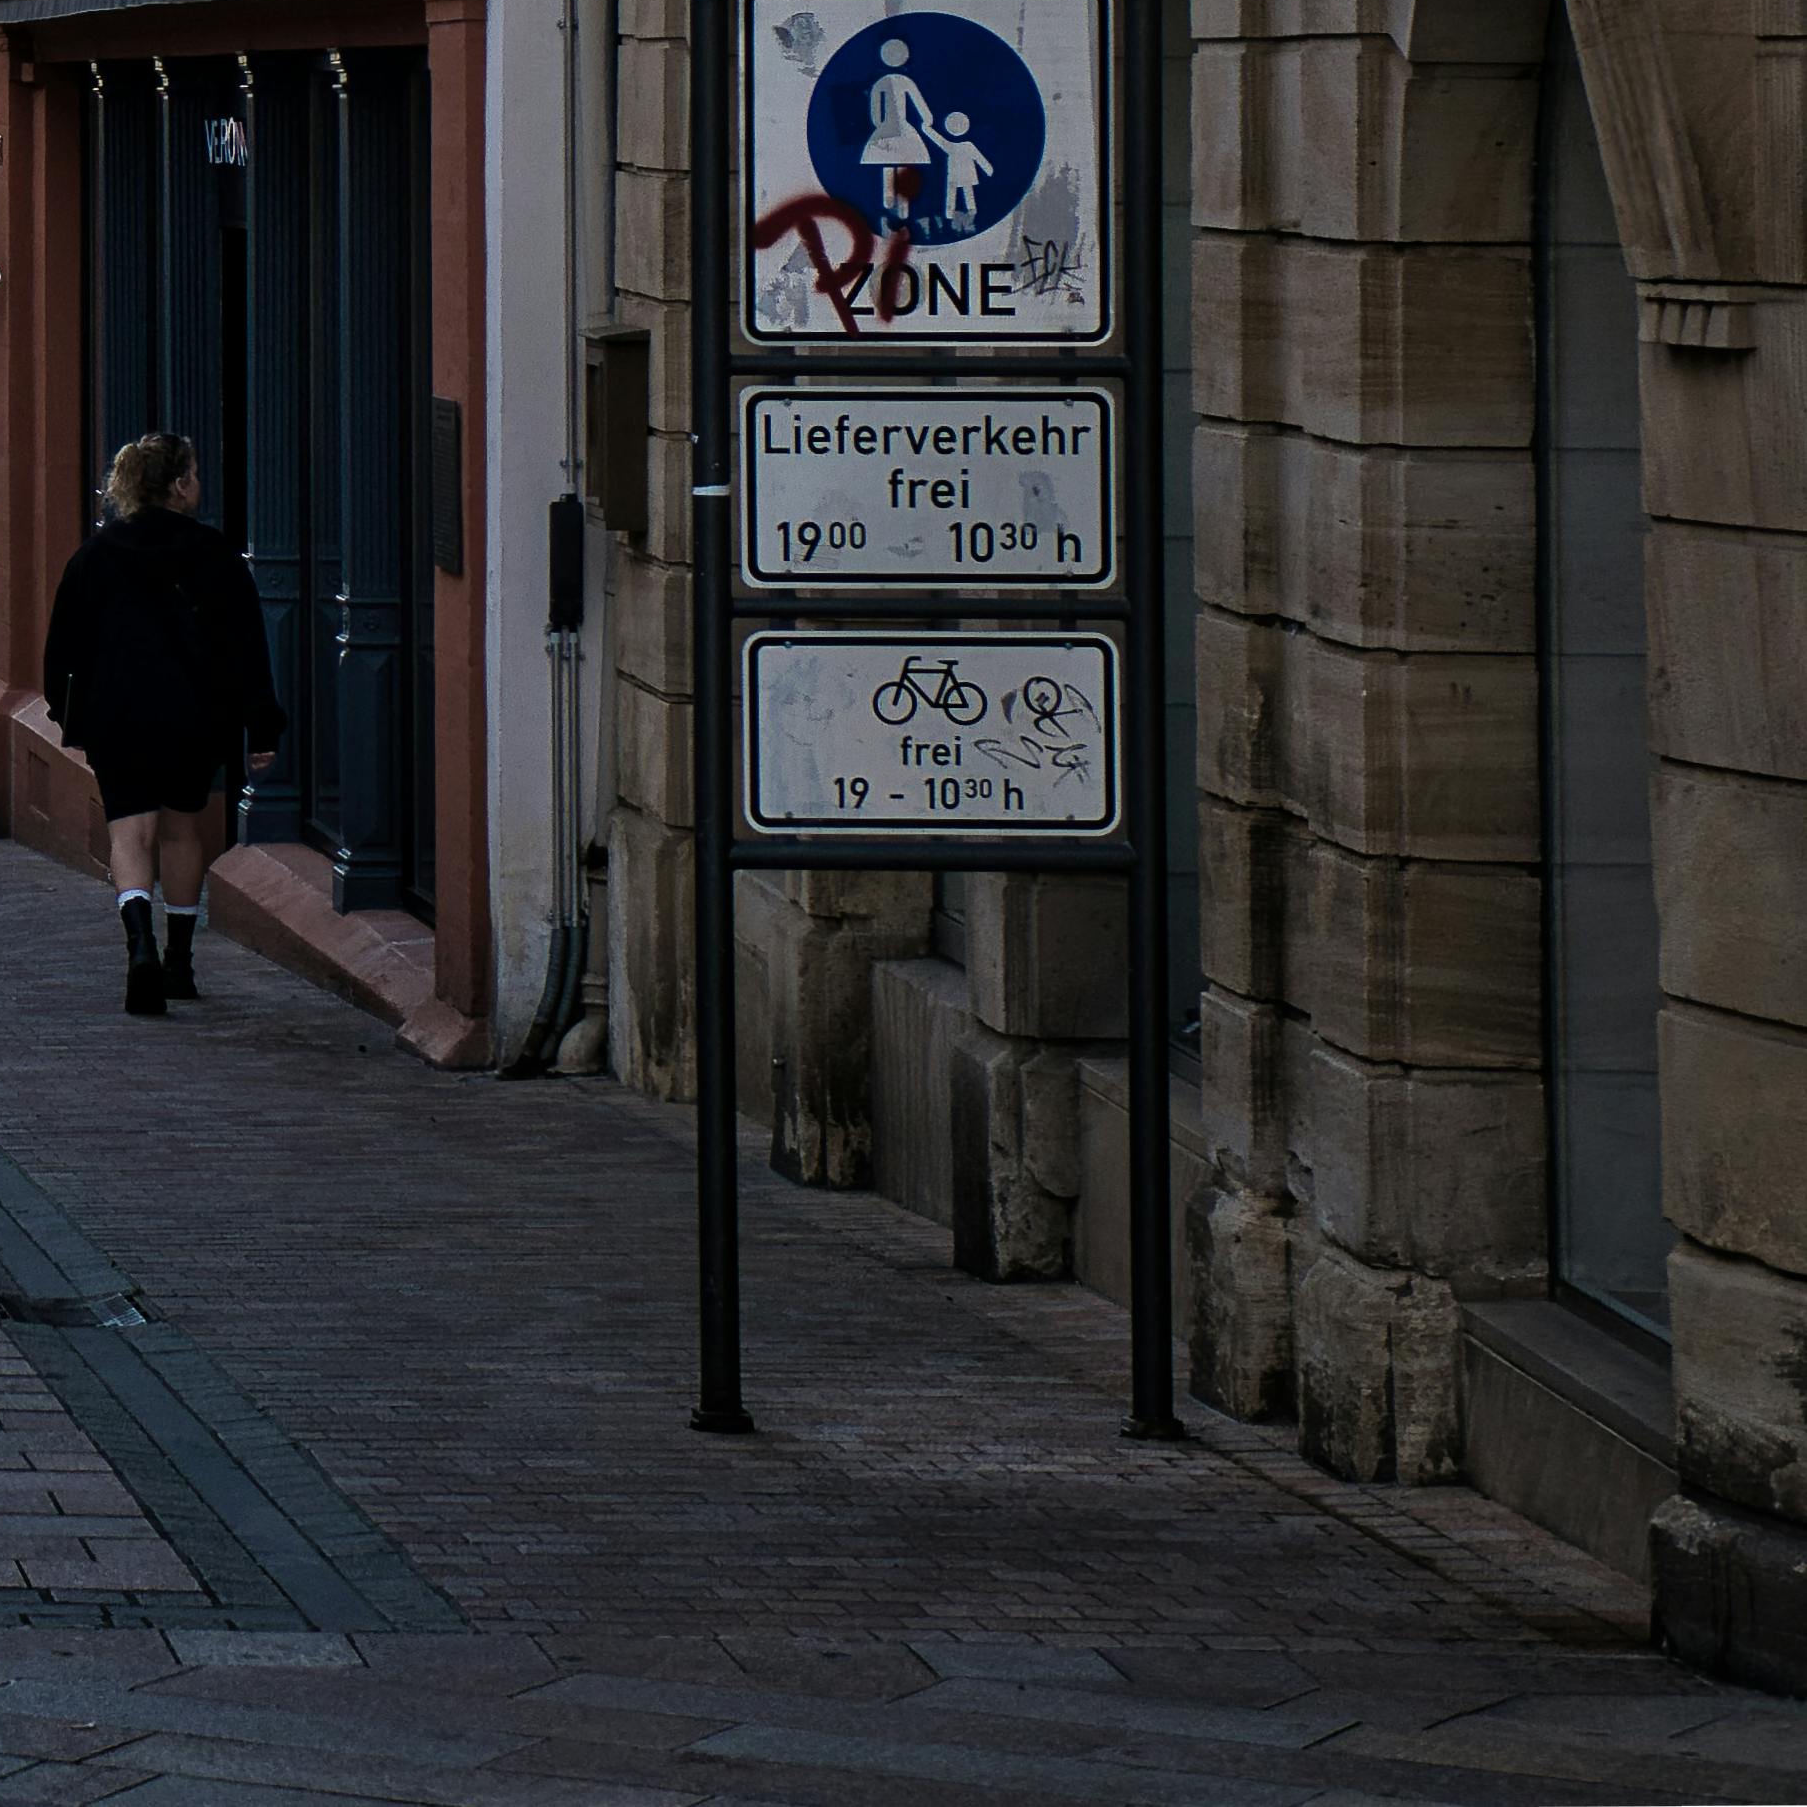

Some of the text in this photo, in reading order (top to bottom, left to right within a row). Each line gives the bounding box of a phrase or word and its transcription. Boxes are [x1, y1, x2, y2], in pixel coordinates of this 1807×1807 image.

[841, 262, 1017, 317] ZONE
[763, 414, 1091, 456] Lieferverkehr
[888, 468, 971, 509] frei
[1056, 523, 1083, 563] h
[900, 735, 963, 766] frei
[833, 777, 870, 810] 19
[1003, 777, 1025, 810] h
